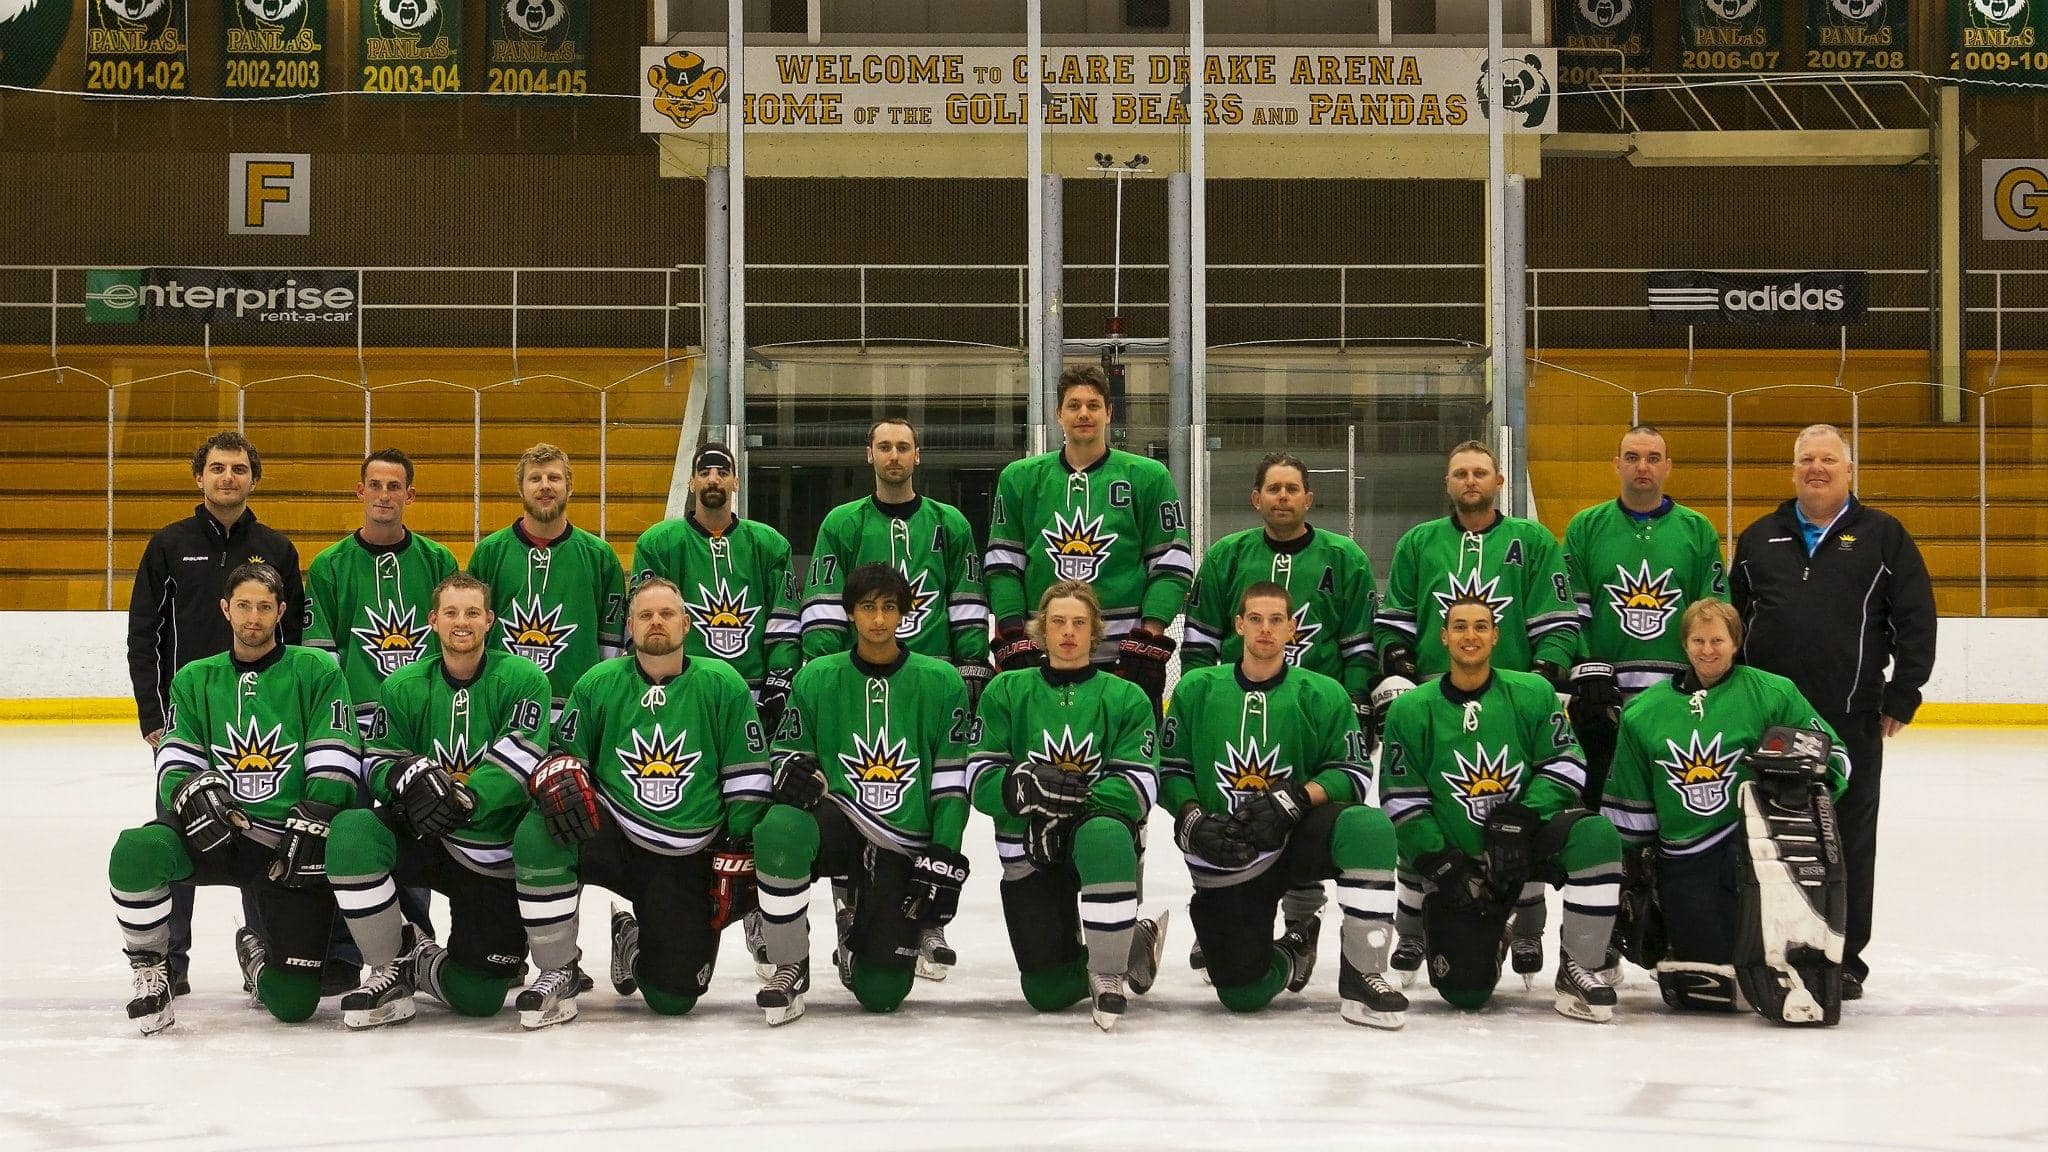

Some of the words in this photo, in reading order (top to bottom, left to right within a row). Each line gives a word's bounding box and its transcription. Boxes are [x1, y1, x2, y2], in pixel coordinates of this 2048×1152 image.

[775, 54, 964, 85] WELCOME
[973, 66, 1002, 84] TO
[1013, 54, 1135, 85] CLARE
[1149, 54, 1277, 85] DRAKE
[1290, 55, 1422, 86] ARENA
[1682, 50, 1780, 70] 2006-07
[1807, 50, 1905, 69] 2007-08
[87, 60, 186, 90] 2001-02
[226, 60, 320, 88] 2002-2003
[363, 64, 461, 93] 2003-04
[488, 68, 588, 96] 2004-05
[677, 72, 689, 85] A
[854, 107, 880, 125] OF
[888, 107, 932, 125] THE
[1112, 93, 1244, 126] BEARS
[1252, 107, 1299, 126] AND
[1309, 93, 1468, 126] PANDAS
[245, 161, 294, 227] F
[1994, 166, 2048, 232] G
[102, 279, 354, 318] enterprise
[1725, 283, 1844, 311] adidas
[260, 310, 353, 322] rent-a-car
[1108, 480, 1132, 508] C
[1159, 500, 1186, 533] 61
[931, 525, 946, 553] A
[1504, 538, 1524, 567] A
[810, 555, 838, 588] 17
[1060, 557, 1096, 581] BC
[1318, 565, 1336, 594] A
[1711, 561, 1726, 594] 2
[1626, 609, 1662, 632] BC
[711, 628, 744, 650] BC
[329, 699, 353, 736] 11
[507, 698, 543, 732] 18
[774, 708, 802, 742] 23
[744, 720, 766, 753] 9
[238, 775, 274, 799] BC
[642, 779, 676, 803] BC
[863, 784, 898, 808] BC
[1686, 785, 1724, 810] BC
